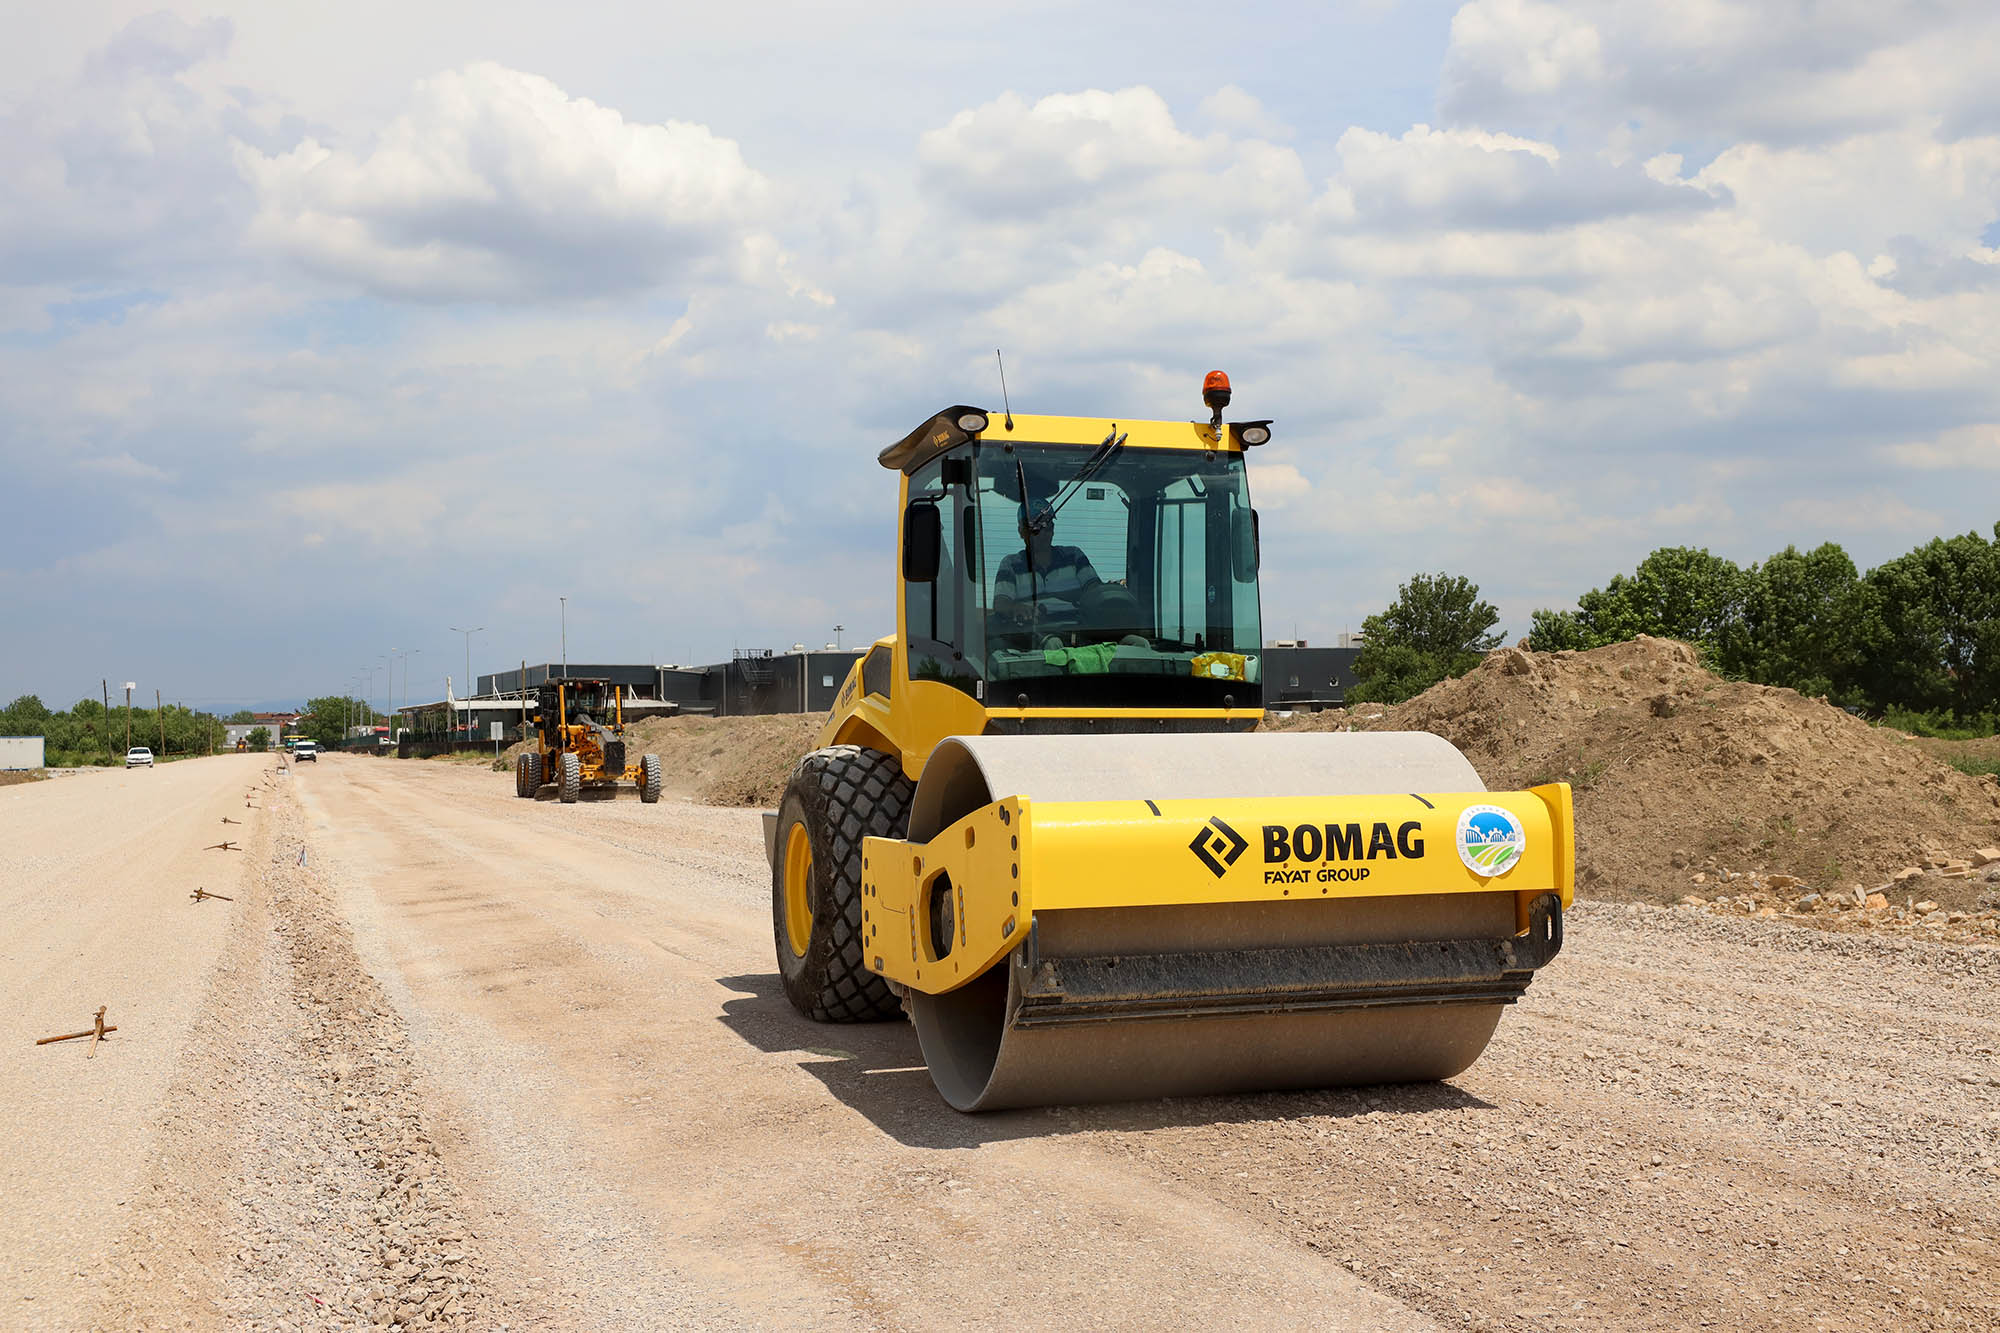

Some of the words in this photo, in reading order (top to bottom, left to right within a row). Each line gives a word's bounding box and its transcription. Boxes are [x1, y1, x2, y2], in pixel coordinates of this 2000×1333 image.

[1262, 821, 1424, 863] BOMAG
[1264, 870, 1311, 884] FAYAT
[1316, 868, 1370, 882] GROUP
